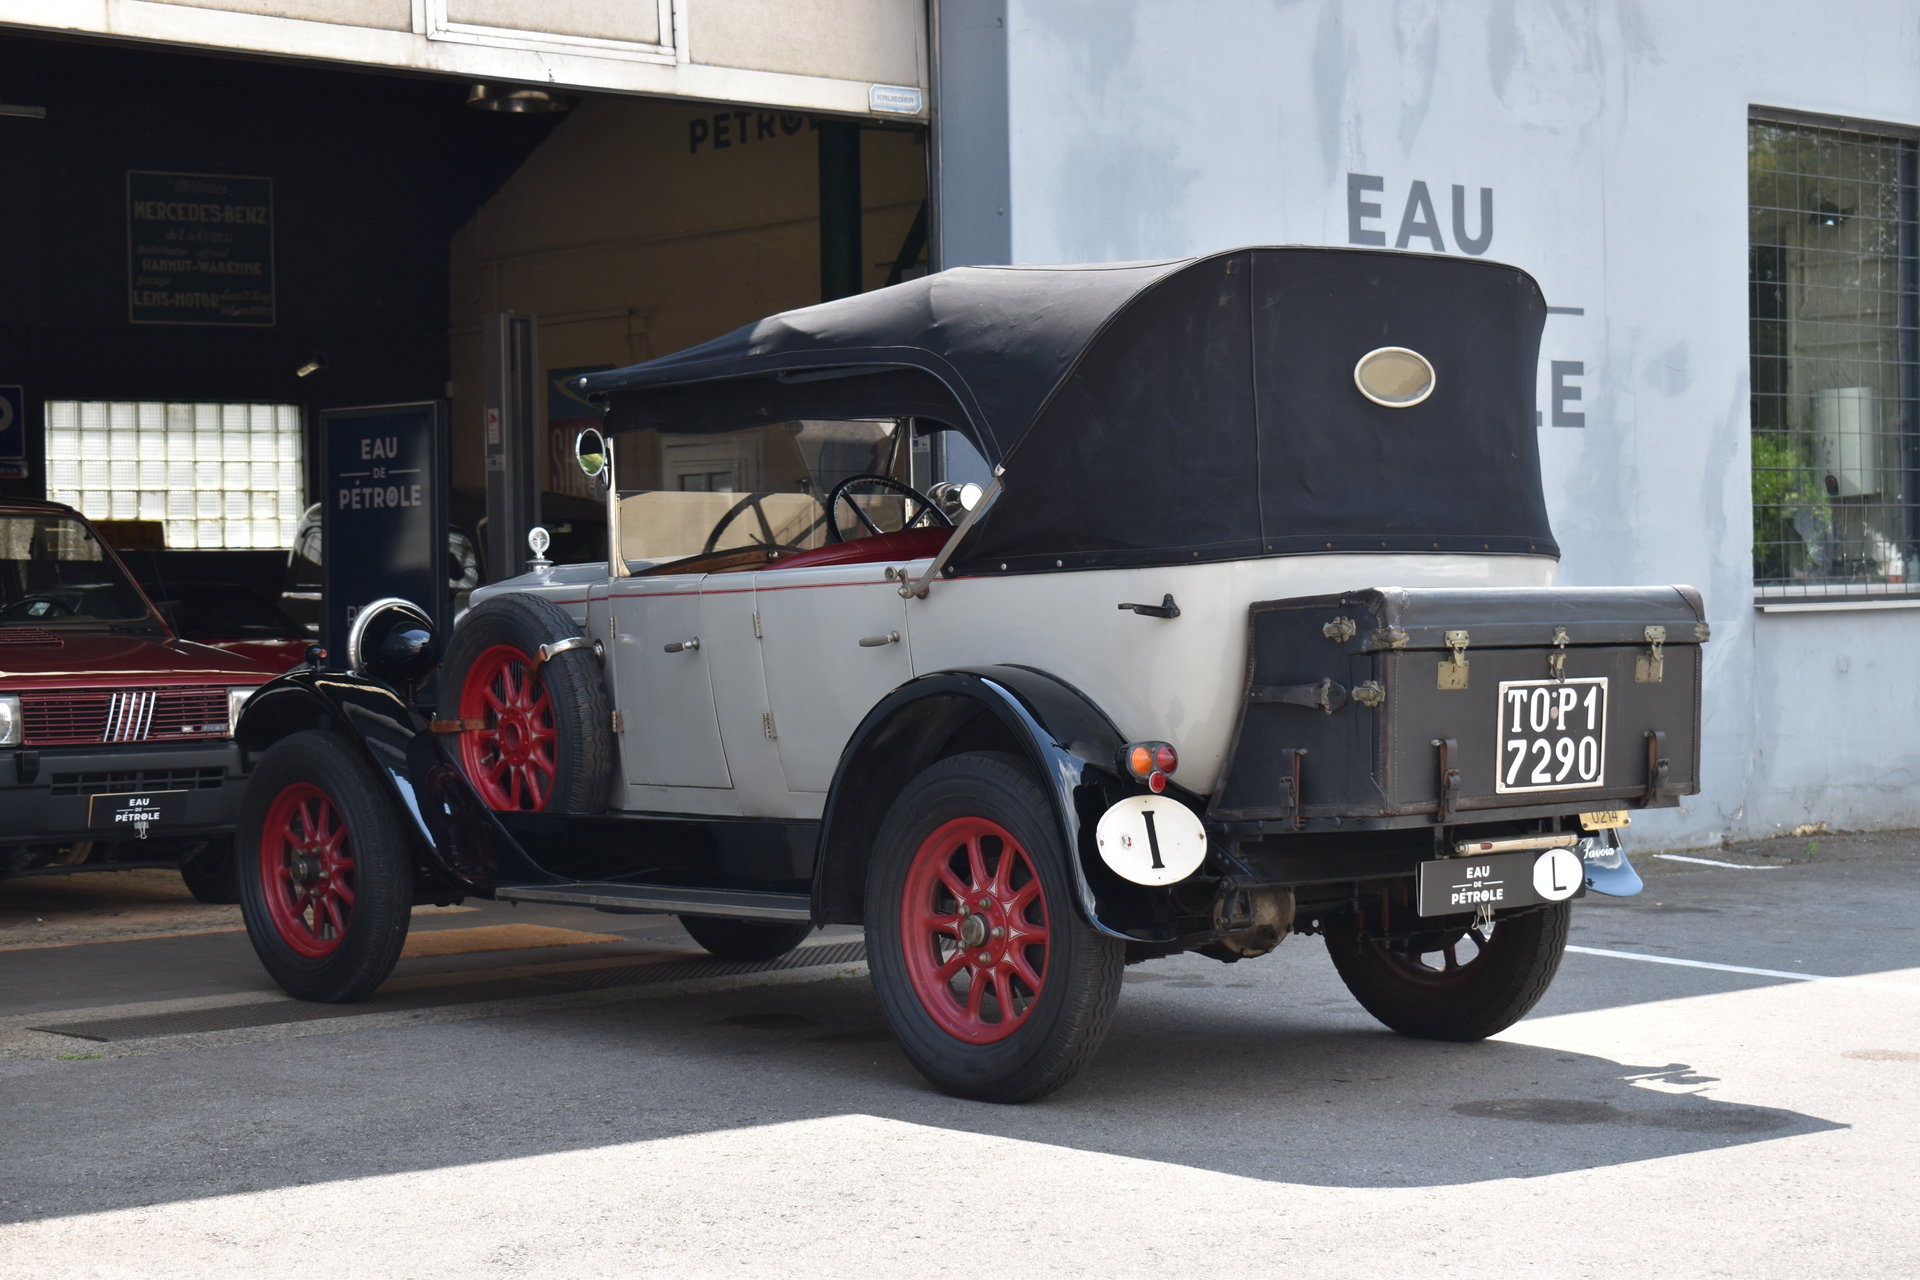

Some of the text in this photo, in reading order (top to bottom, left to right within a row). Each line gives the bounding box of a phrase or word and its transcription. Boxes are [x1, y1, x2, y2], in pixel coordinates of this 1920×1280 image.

[134, 200, 268, 225] MERCEDES-BENZ
[1347, 172, 1494, 256] EAU
[360, 436, 399, 460] EAU
[372, 467, 387, 479] DE
[339, 479, 422, 510] PÉTROLE
[1506, 735, 1598, 785] 7290
[129, 798, 150, 806] EAU
[115, 811, 160, 822] PÉTROLE
[1141, 810, 1165, 869] I
[1466, 865, 1491, 879] EAU
[1473, 880, 1482, 888] DE
[1551, 856, 1567, 891] L
[1451, 888, 1504, 905] PÉTROLE
